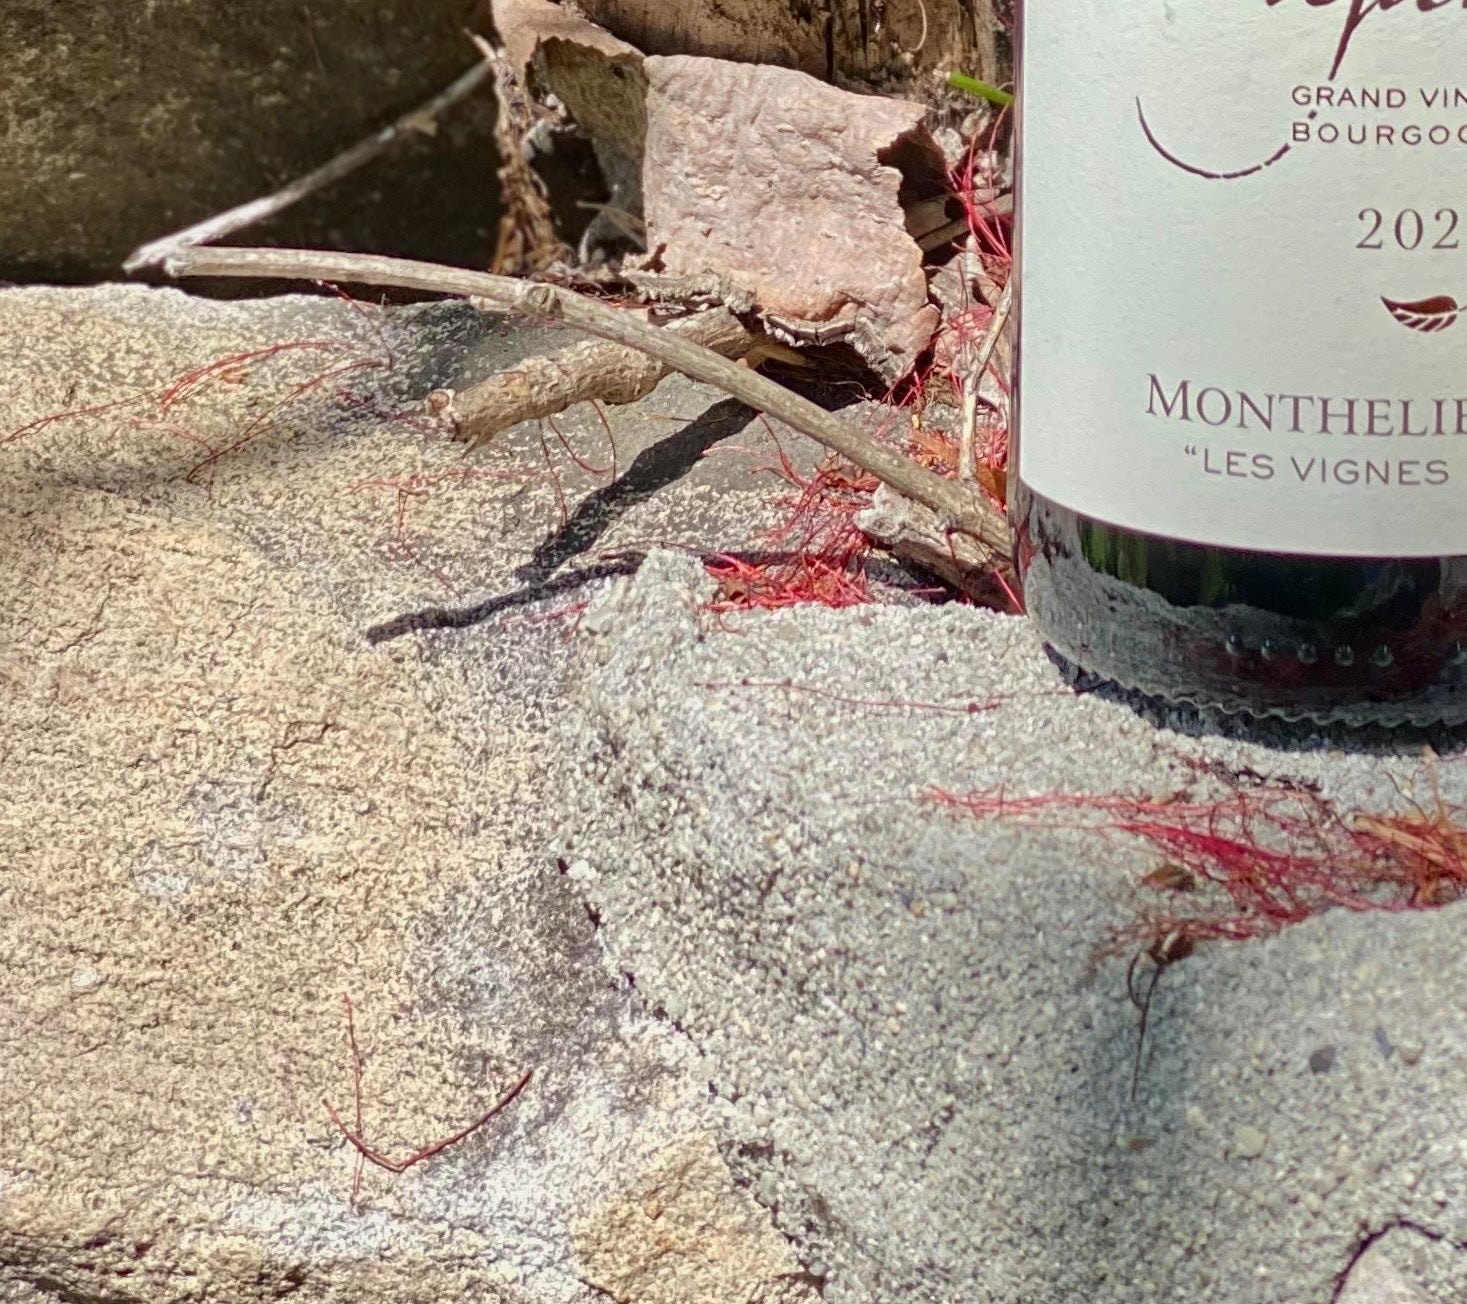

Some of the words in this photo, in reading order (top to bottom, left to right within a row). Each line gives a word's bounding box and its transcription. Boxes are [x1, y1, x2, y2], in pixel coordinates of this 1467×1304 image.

[1291, 85, 1407, 109] GRAND
[1184, 445, 1275, 481] “LES
[1291, 457, 1449, 486] VIGNES
